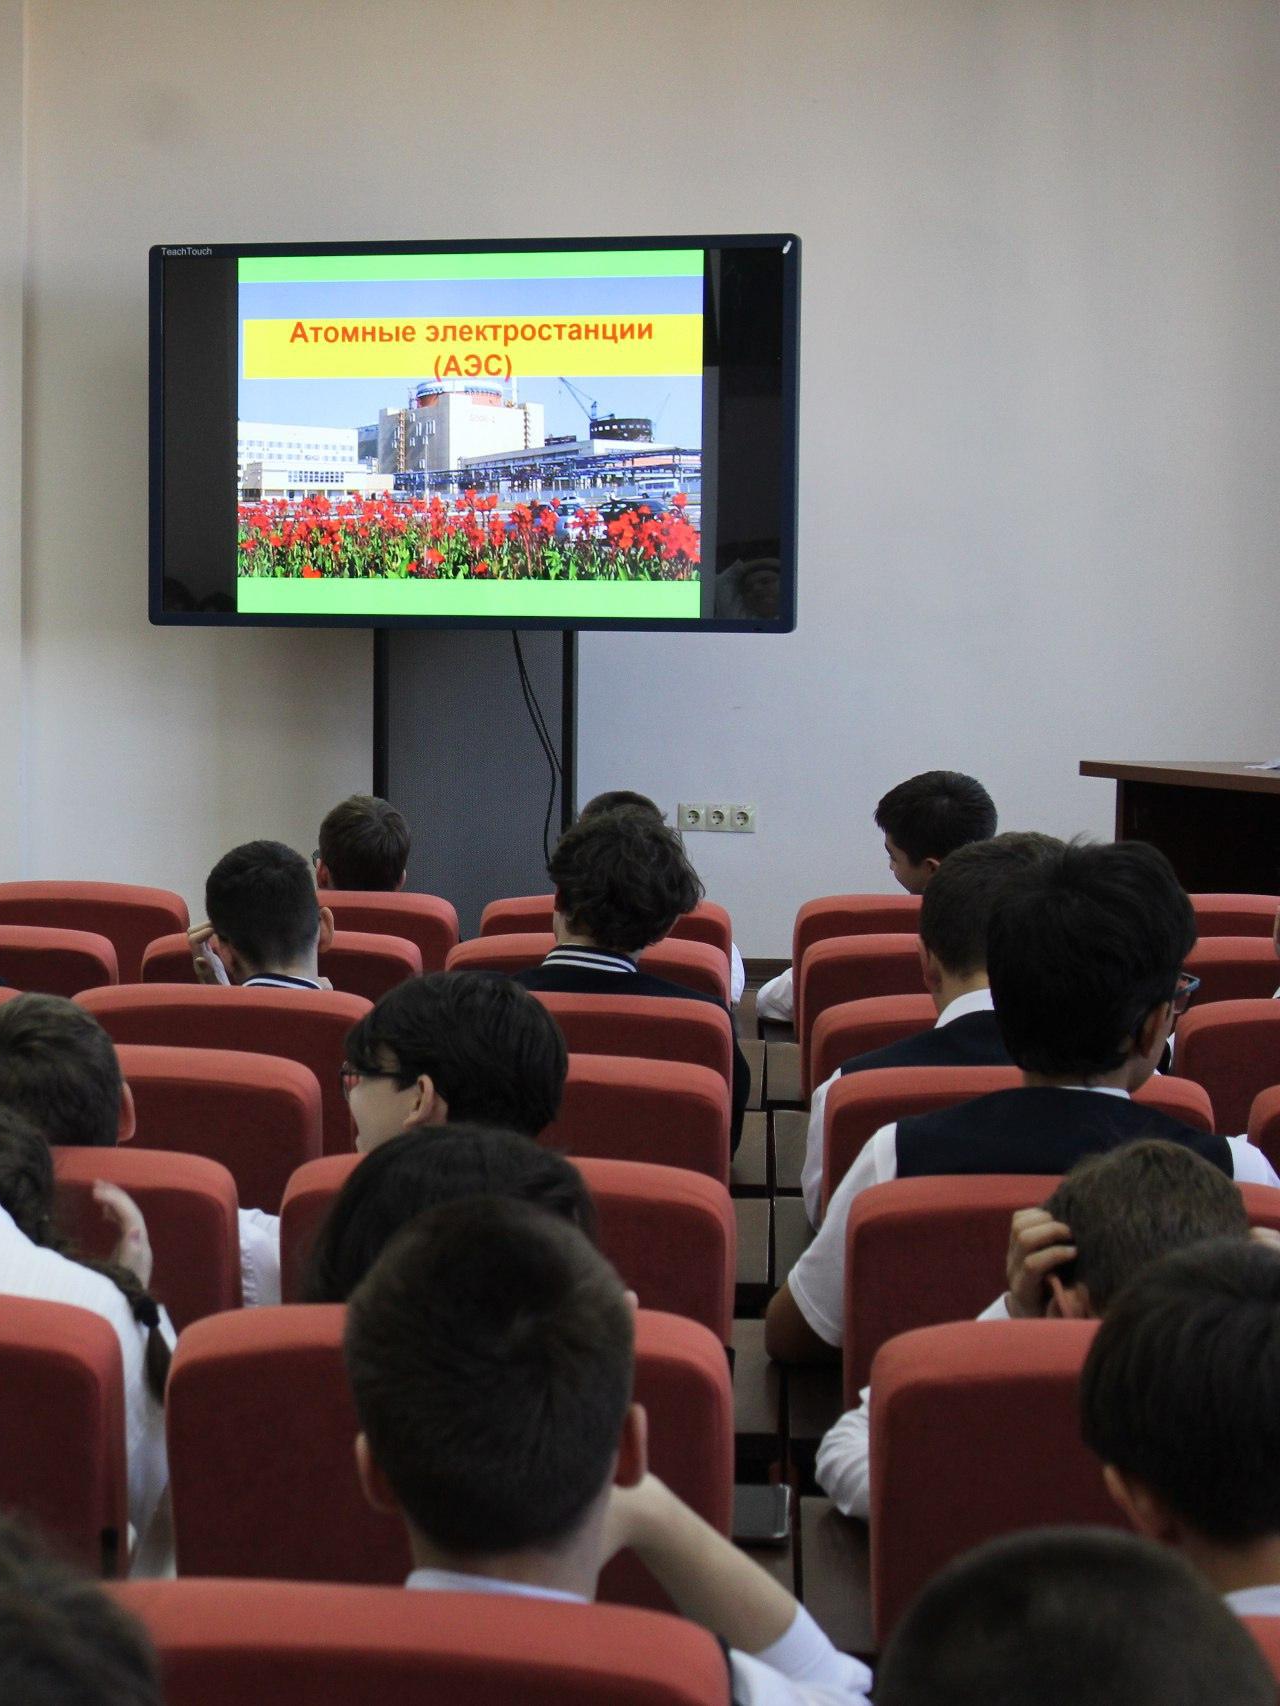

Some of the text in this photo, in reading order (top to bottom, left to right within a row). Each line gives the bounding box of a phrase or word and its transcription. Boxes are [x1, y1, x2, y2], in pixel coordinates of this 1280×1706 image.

[161, 247, 213, 256] TeachTouch
[289, 321, 654, 347] Атомные электростанции
[433, 353, 512, 382] (АЭС)
